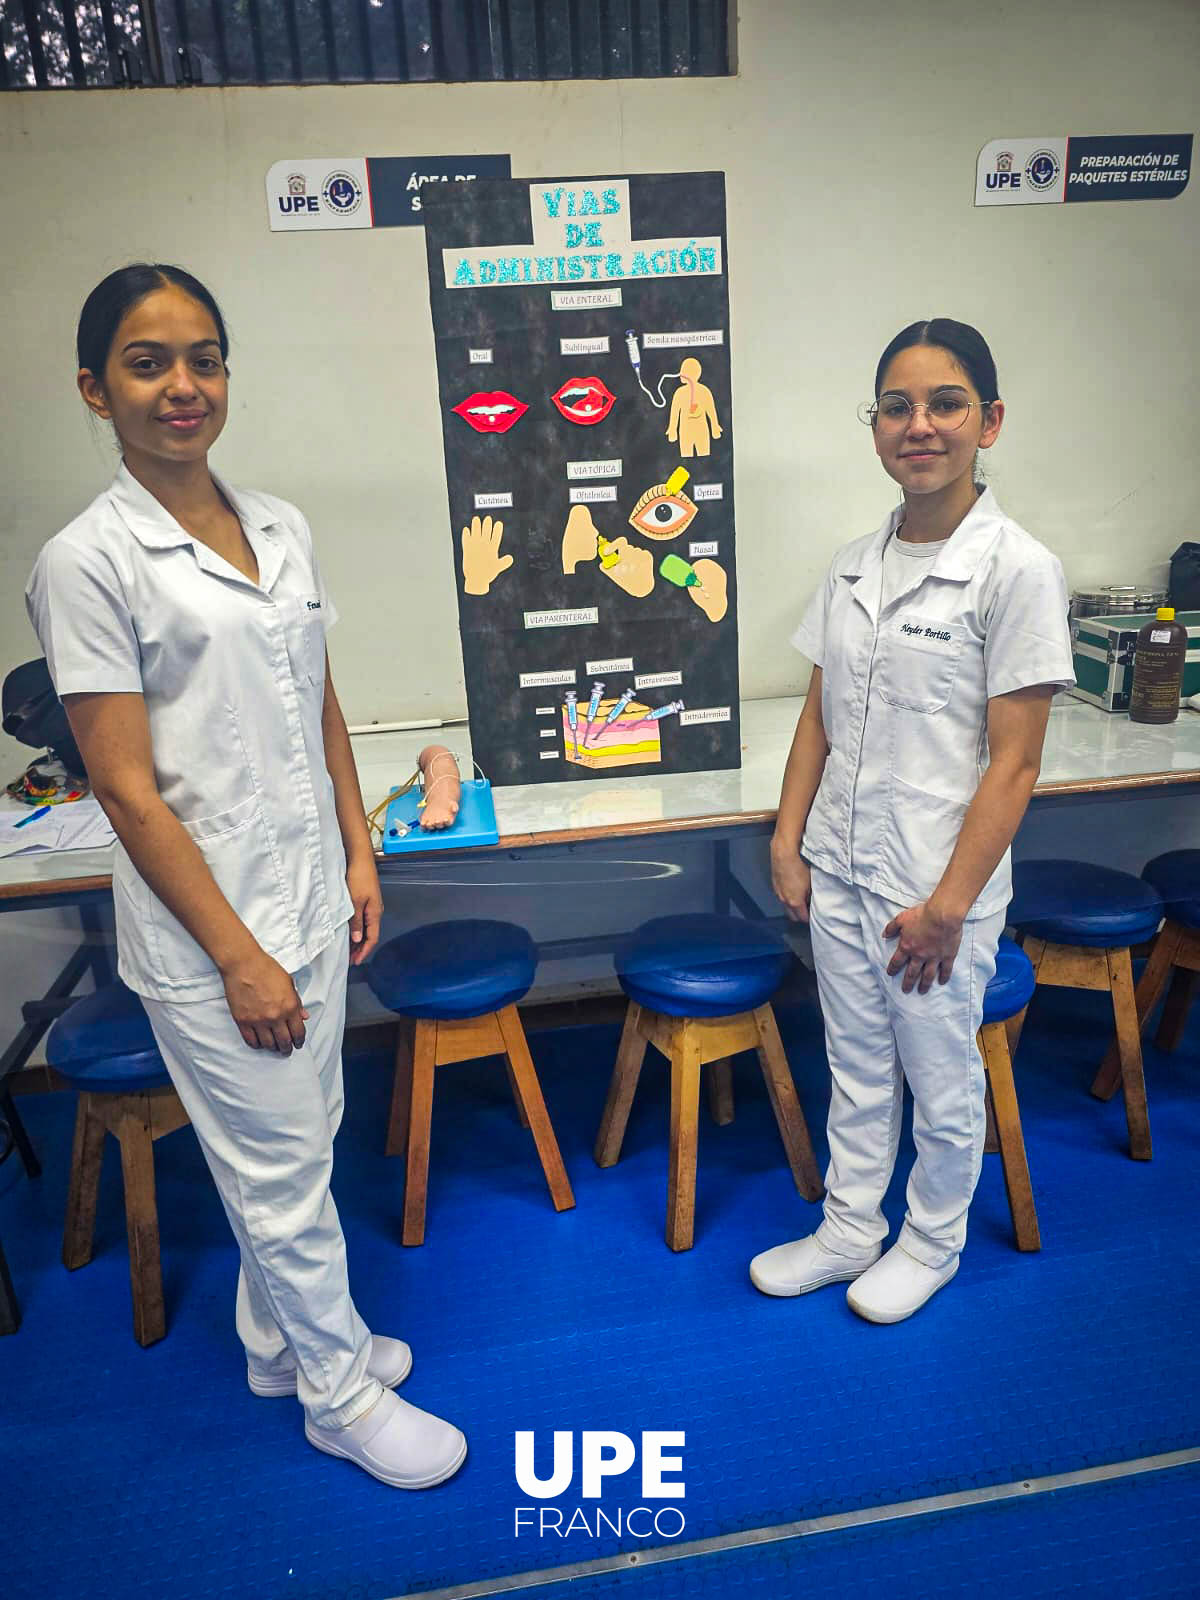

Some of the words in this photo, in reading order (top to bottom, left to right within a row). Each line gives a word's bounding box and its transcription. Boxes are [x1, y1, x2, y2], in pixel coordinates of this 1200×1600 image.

[1080, 152, 1161, 167] PREPARACIÓN
[1162, 154, 1180, 166] DE
[985, 172, 1021, 189] UPE
[1069, 171, 1128, 186] PAQUETES
[1130, 168, 1187, 182] ESTÉRILES
[278, 195, 320, 213] UPE
[565, 222, 604, 249] DE
[453, 240, 717, 286] ADMINISTRACIÓN
[575, 294, 613, 305] ENTERAL
[564, 341, 604, 355] Sublingual
[472, 351, 488, 361] Oral
[694, 544, 715, 555] Nasal
[544, 613, 593, 624] PARENTERAL
[924, 628, 951, 641] Portillo
[638, 674, 680, 686] Intravenosa
